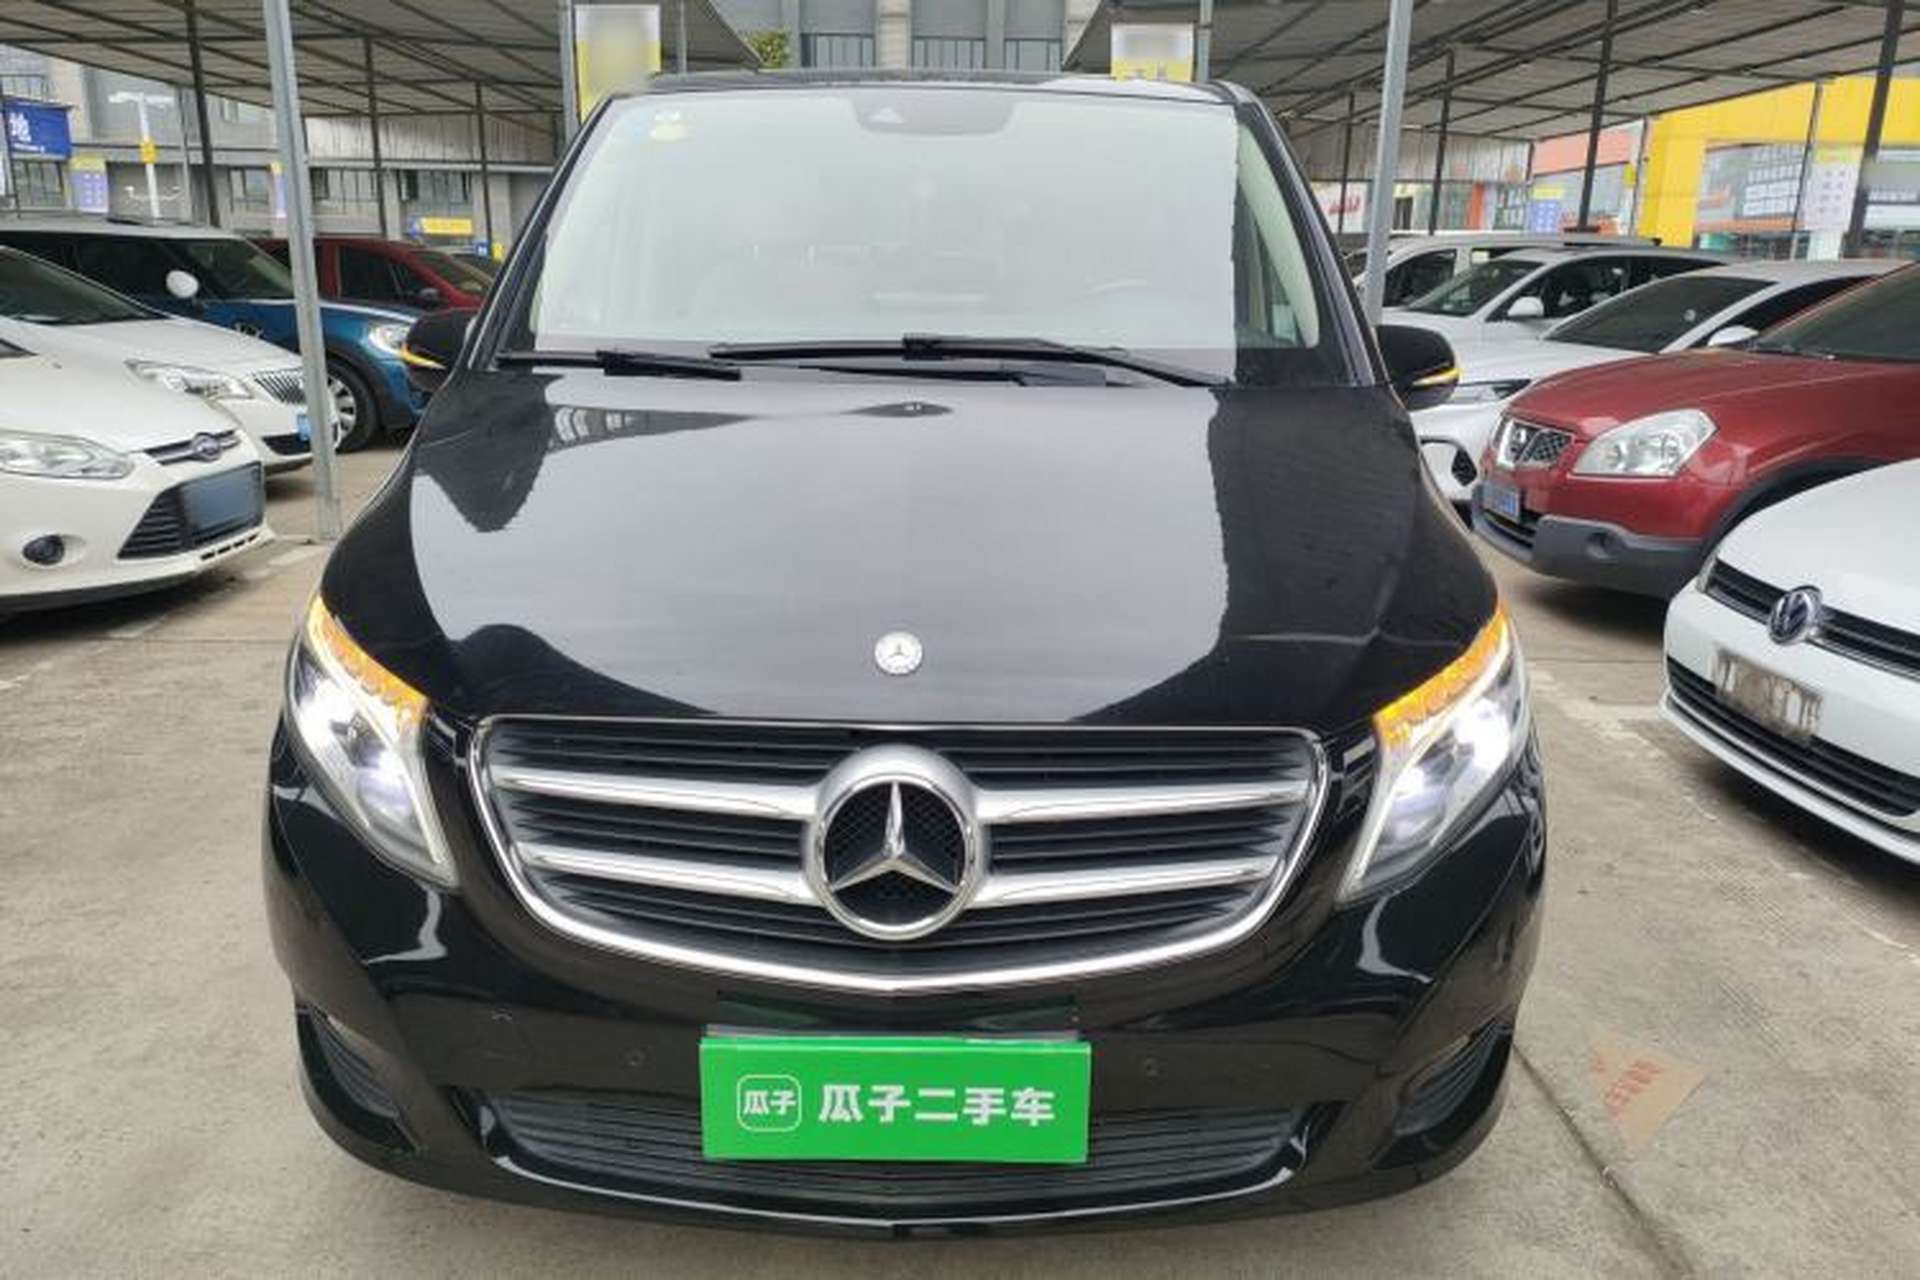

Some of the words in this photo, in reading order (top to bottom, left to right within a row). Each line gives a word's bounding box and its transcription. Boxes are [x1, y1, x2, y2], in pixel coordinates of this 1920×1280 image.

[742, 1089, 797, 1117] 瓜子
[819, 1084, 1056, 1127] 瓜子二手车
